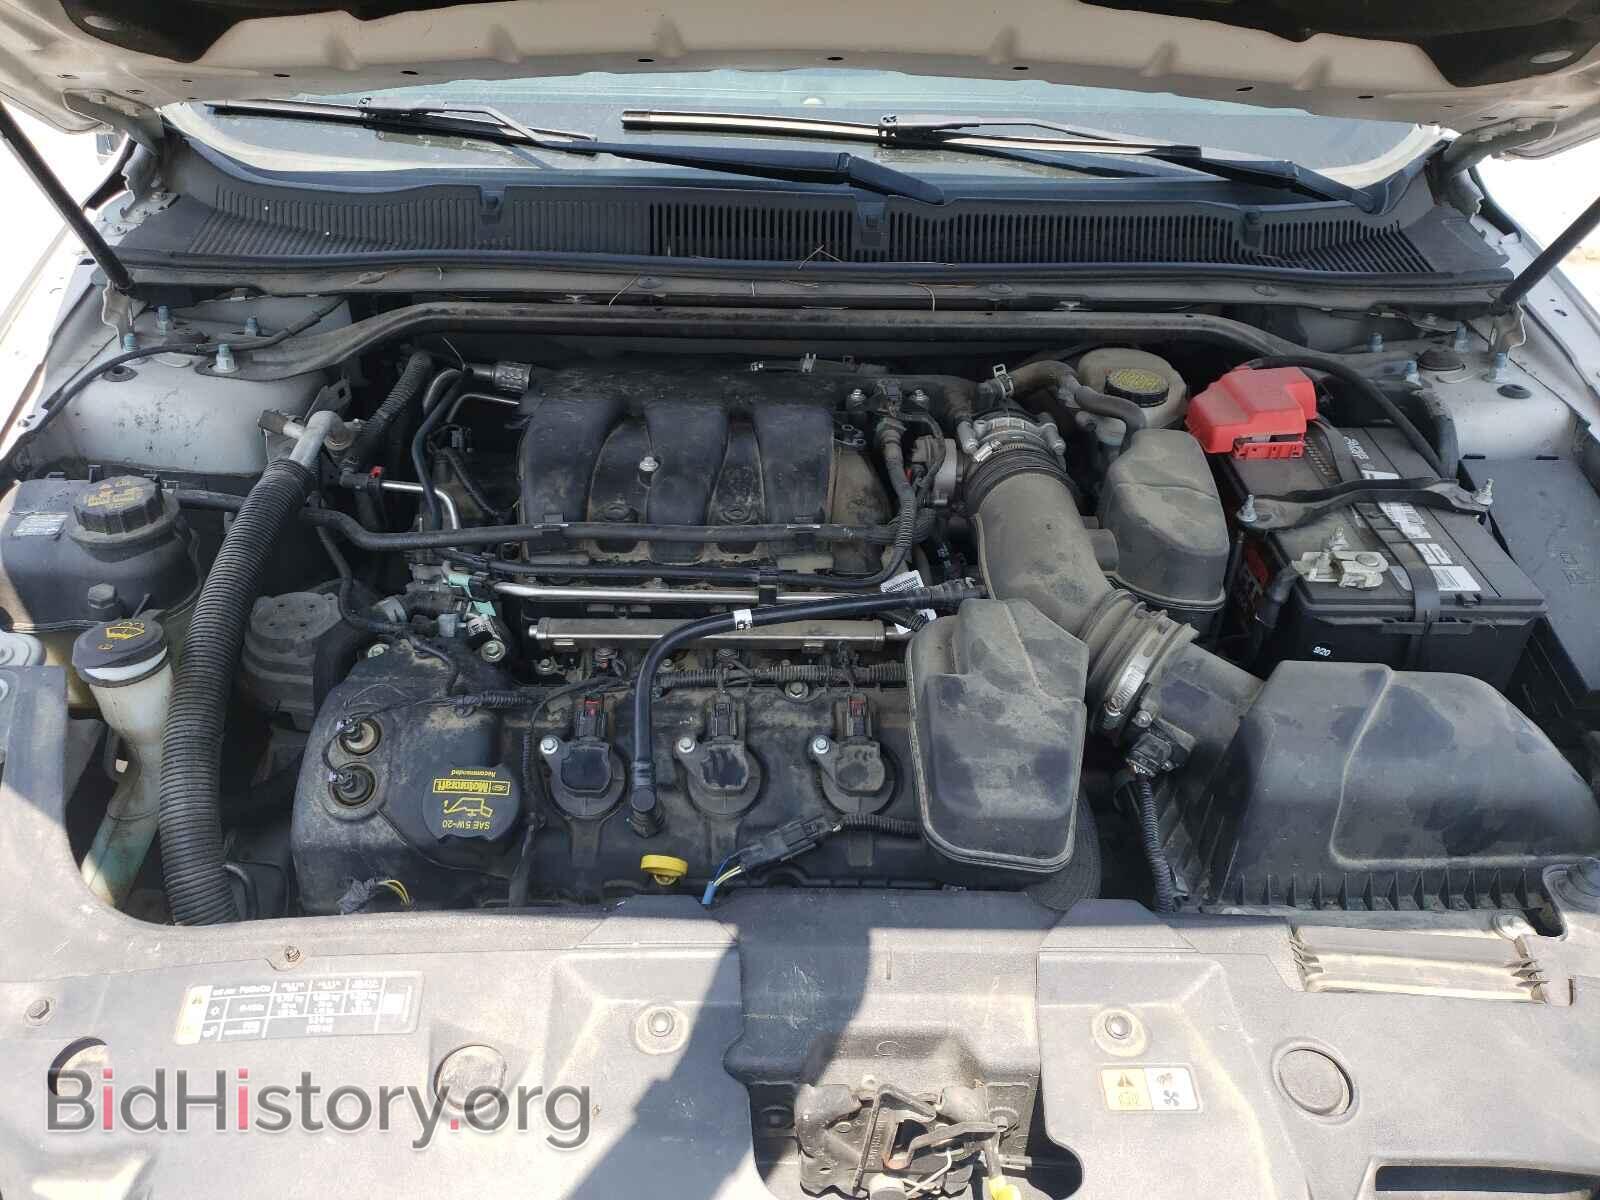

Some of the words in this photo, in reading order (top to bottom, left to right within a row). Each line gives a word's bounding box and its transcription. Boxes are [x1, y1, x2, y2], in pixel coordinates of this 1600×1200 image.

[451, 769, 496, 777] Recommended
[437, 781, 488, 792] Motorcraft
[442, 820, 471, 830] 5W-20
[473, 821, 490, 830] SAE
